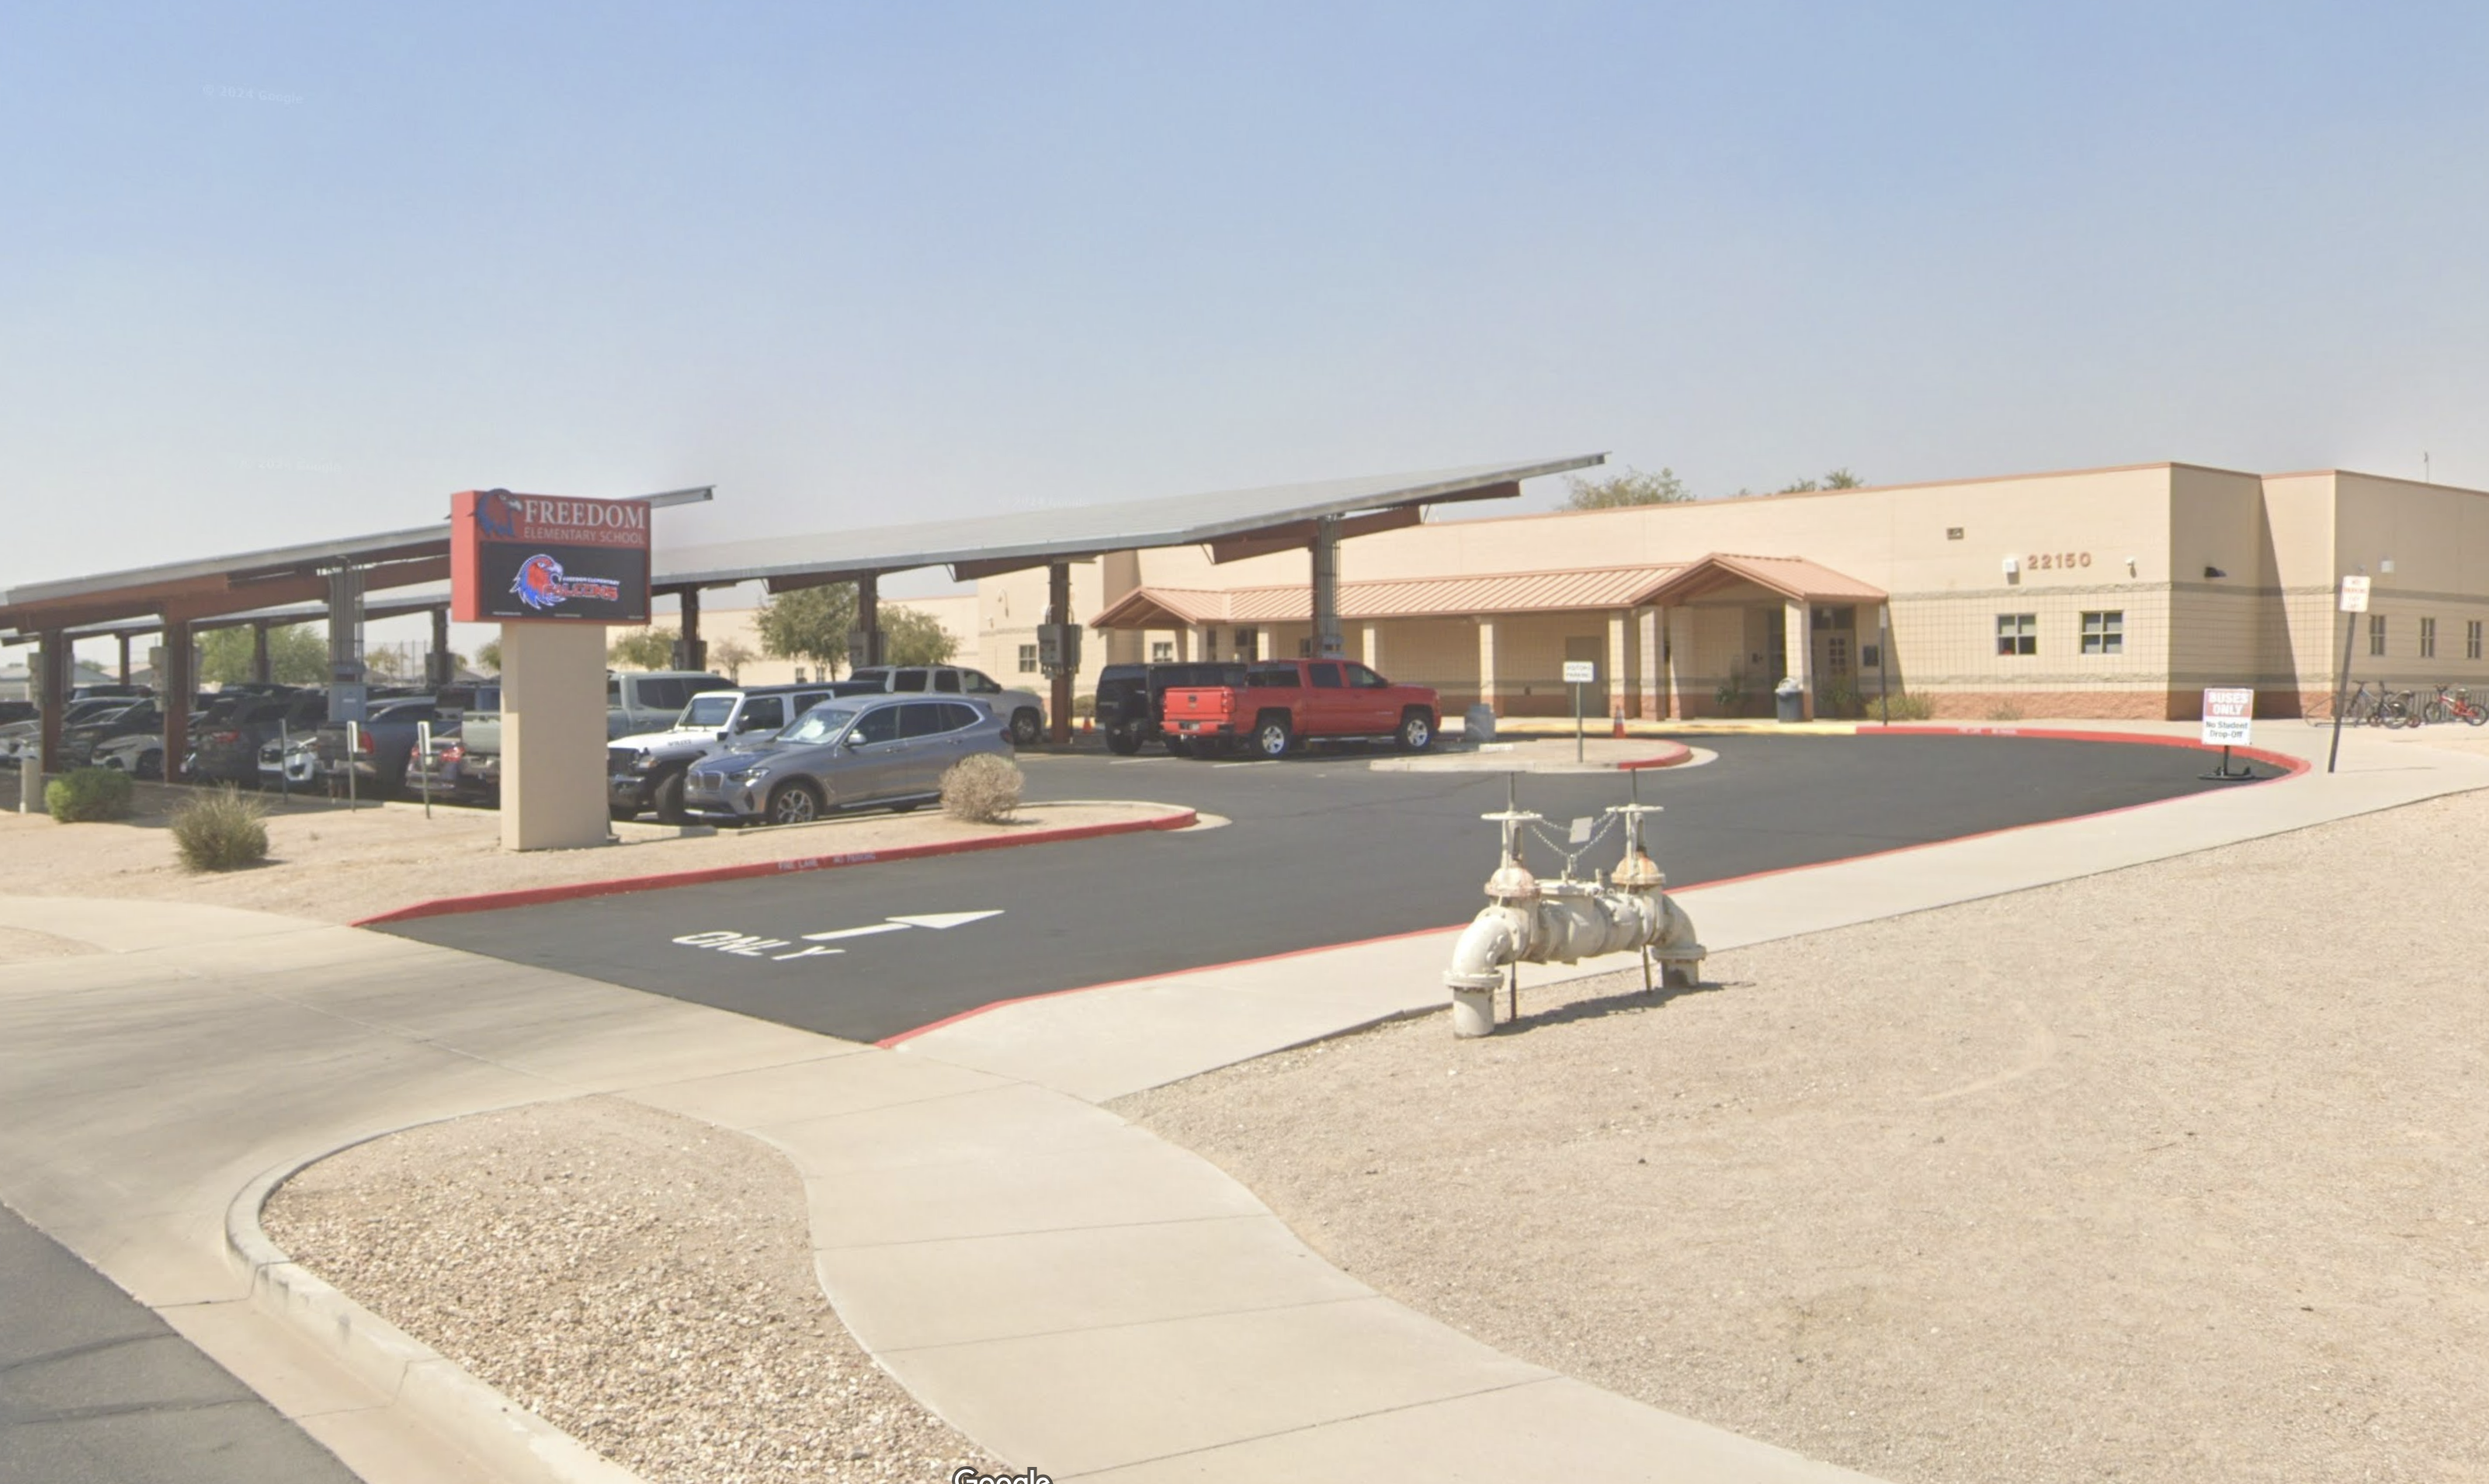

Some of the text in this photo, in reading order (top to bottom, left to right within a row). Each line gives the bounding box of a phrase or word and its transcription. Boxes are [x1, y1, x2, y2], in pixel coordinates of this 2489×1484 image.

[524, 499, 645, 529] FREEDOM
[524, 526, 644, 544] ELEMENTARY SCHOOL
[2027, 551, 2092, 570] 22150
[544, 582, 619, 602] FALCONS
[2208, 692, 2249, 704] BUSES
[2213, 704, 2244, 715] ONLY
[2210, 730, 2244, 739] Drop-Off
[672, 931, 846, 961] ONLY
